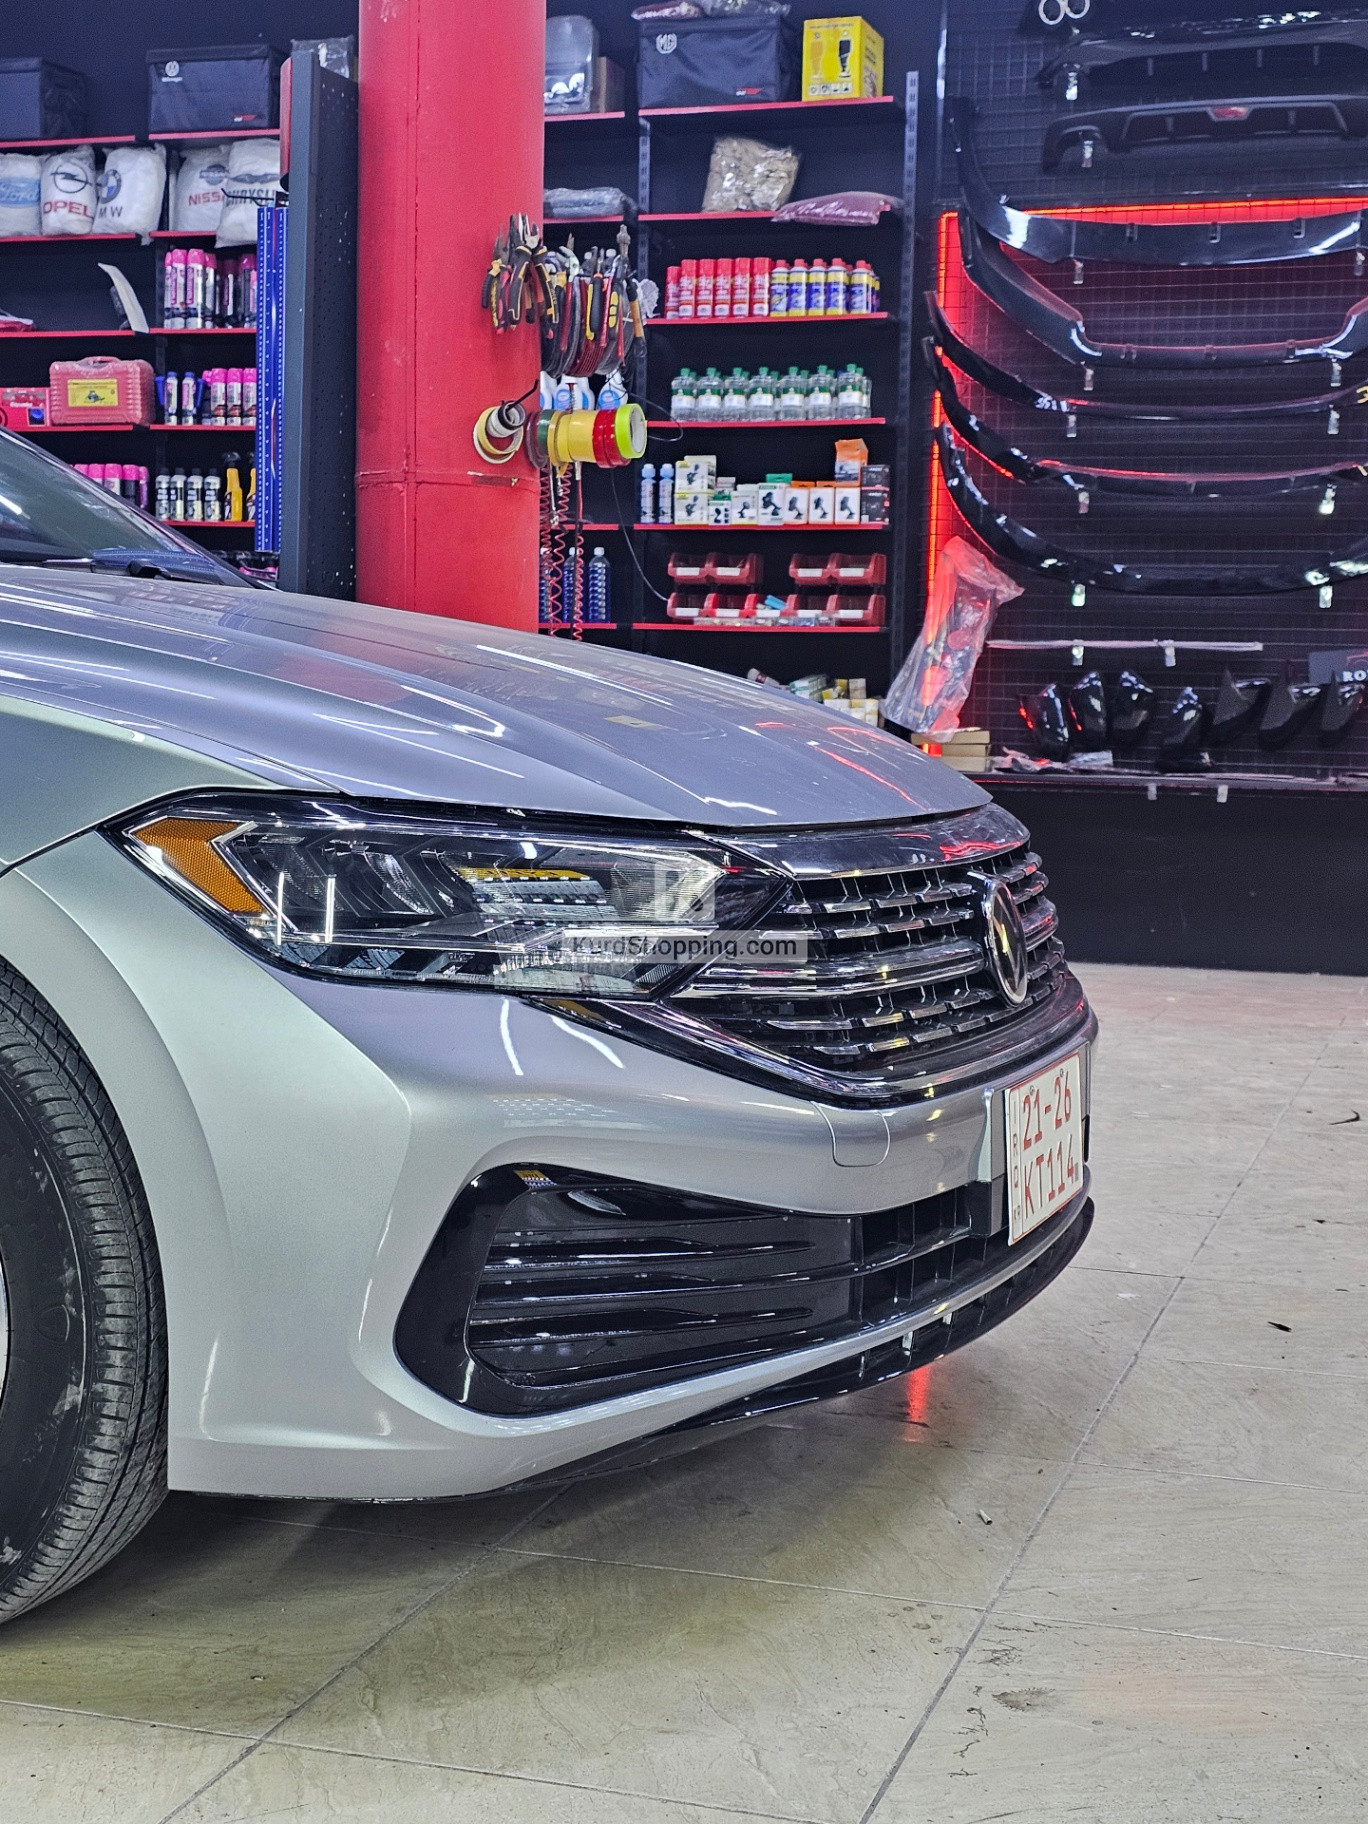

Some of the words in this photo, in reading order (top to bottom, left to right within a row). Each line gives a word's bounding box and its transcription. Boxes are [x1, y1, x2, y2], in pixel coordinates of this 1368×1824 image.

[188, 191, 225, 206] NISS
[227, 188, 276, 207] CHRYSL
[43, 201, 94, 221] OPEL
[98, 205, 123, 218] MW
[1342, 669, 1368, 682] RO
[1022, 1070, 1072, 1151] 21-26
[1023, 1133, 1076, 1220] KT114
